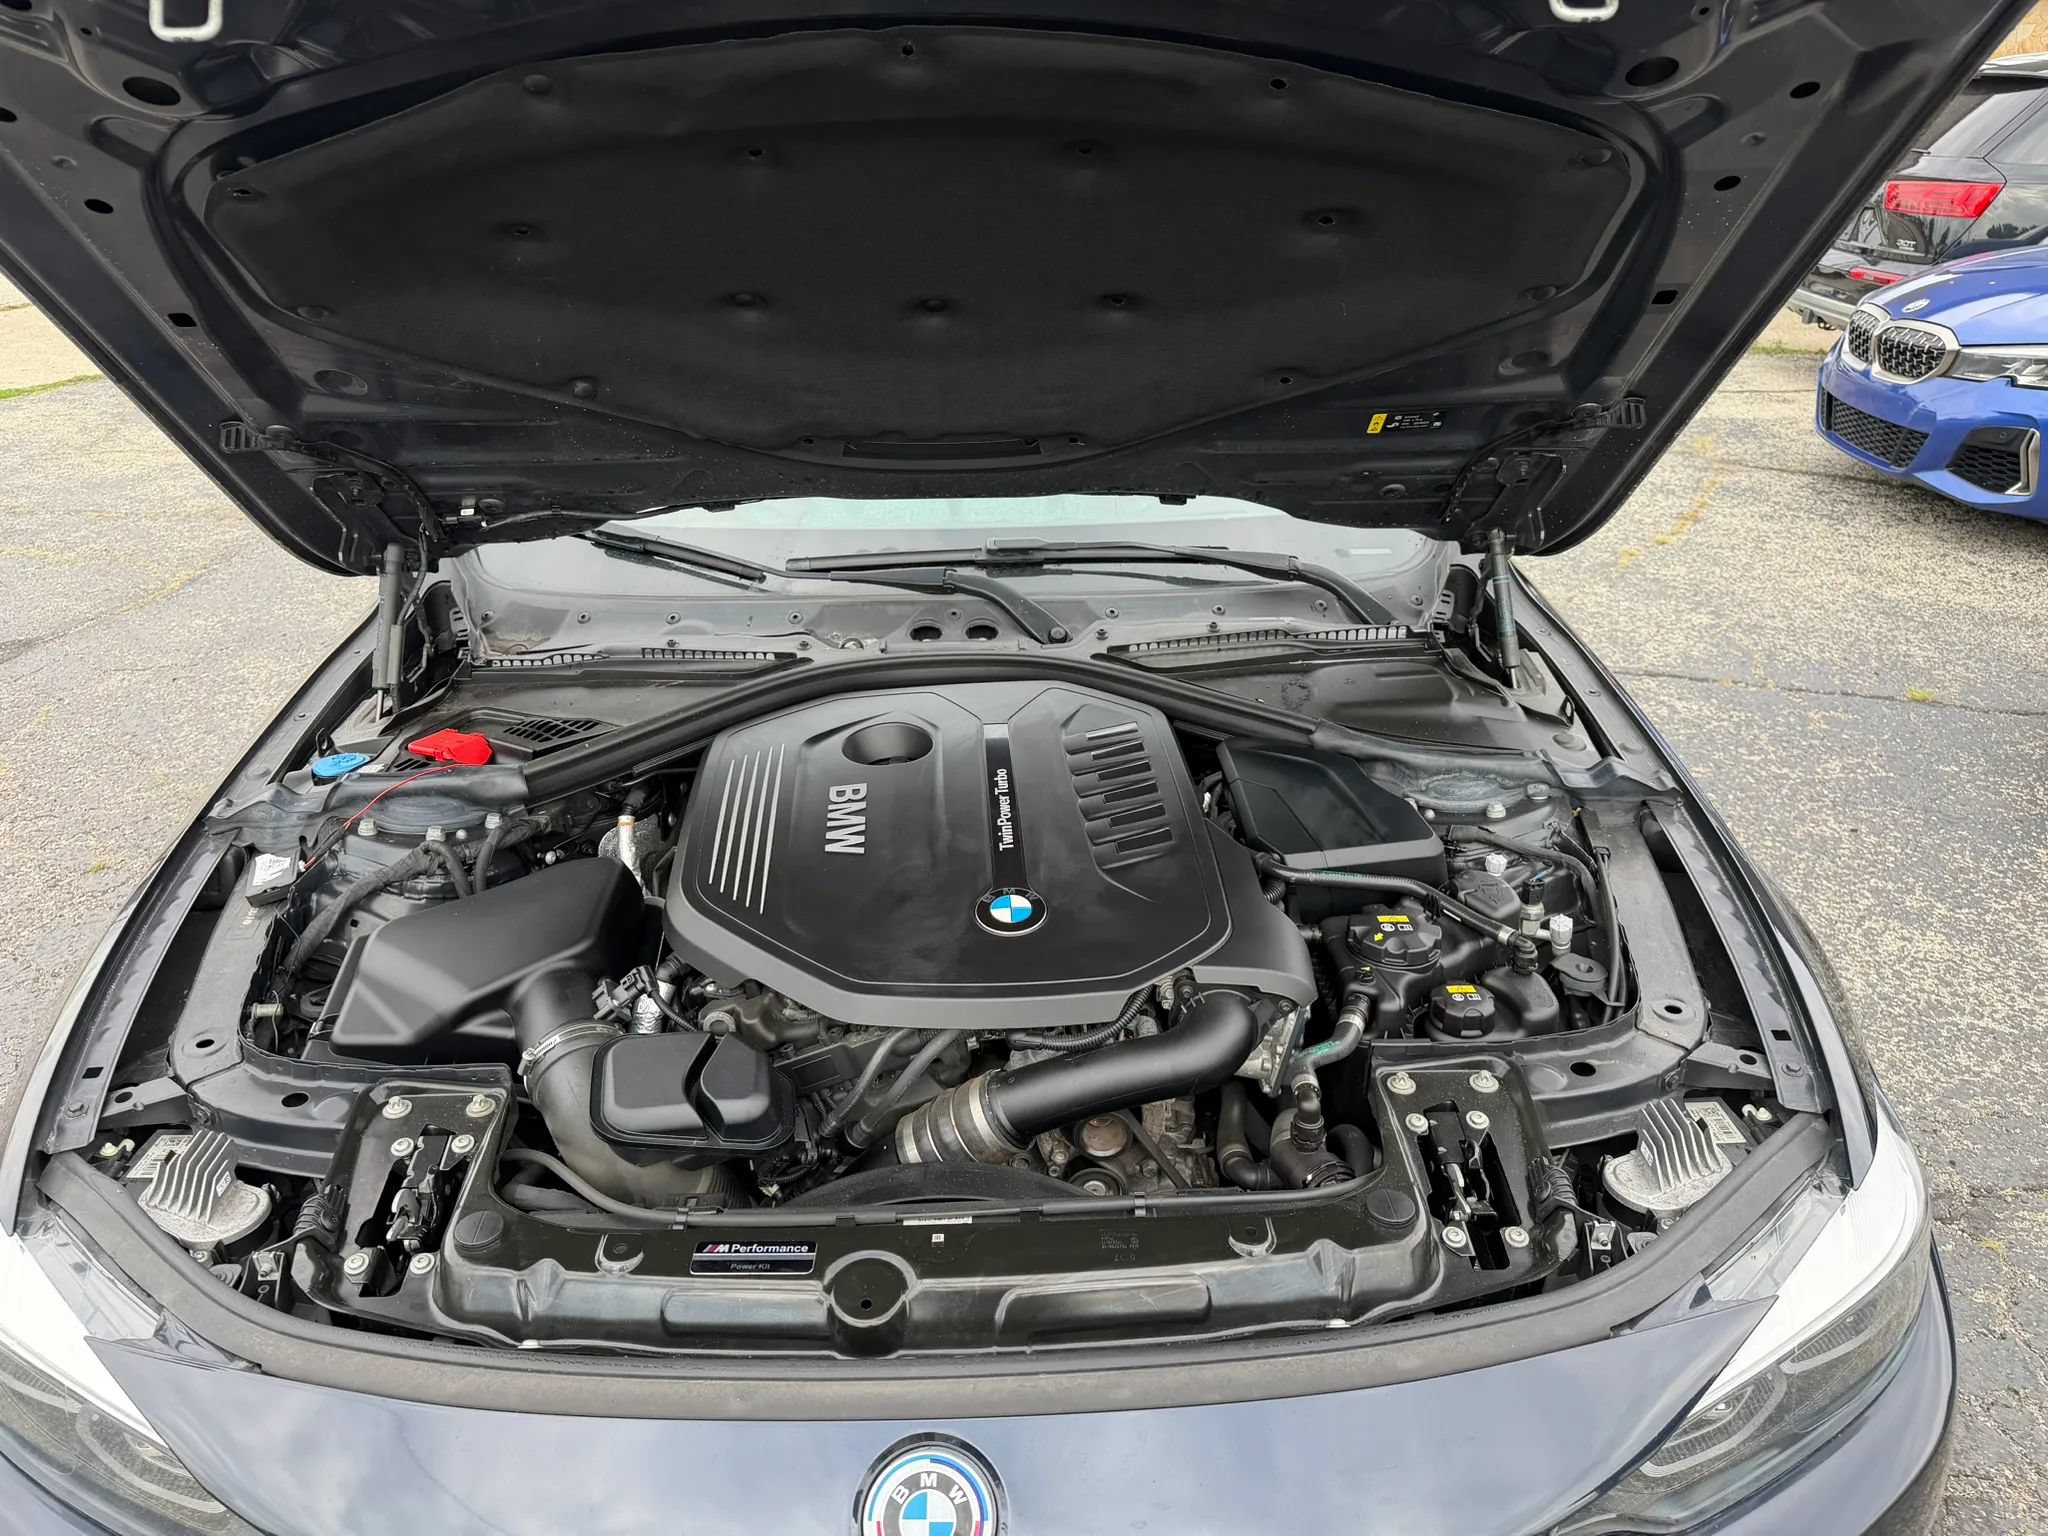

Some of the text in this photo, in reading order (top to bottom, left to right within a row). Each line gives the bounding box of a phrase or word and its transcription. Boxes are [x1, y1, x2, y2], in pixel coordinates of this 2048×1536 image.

[824, 782, 867, 854] BMW
[982, 888, 1041, 903] BMW
[731, 1244, 809, 1253] Performance
[891, 1472, 968, 1505] BMW
